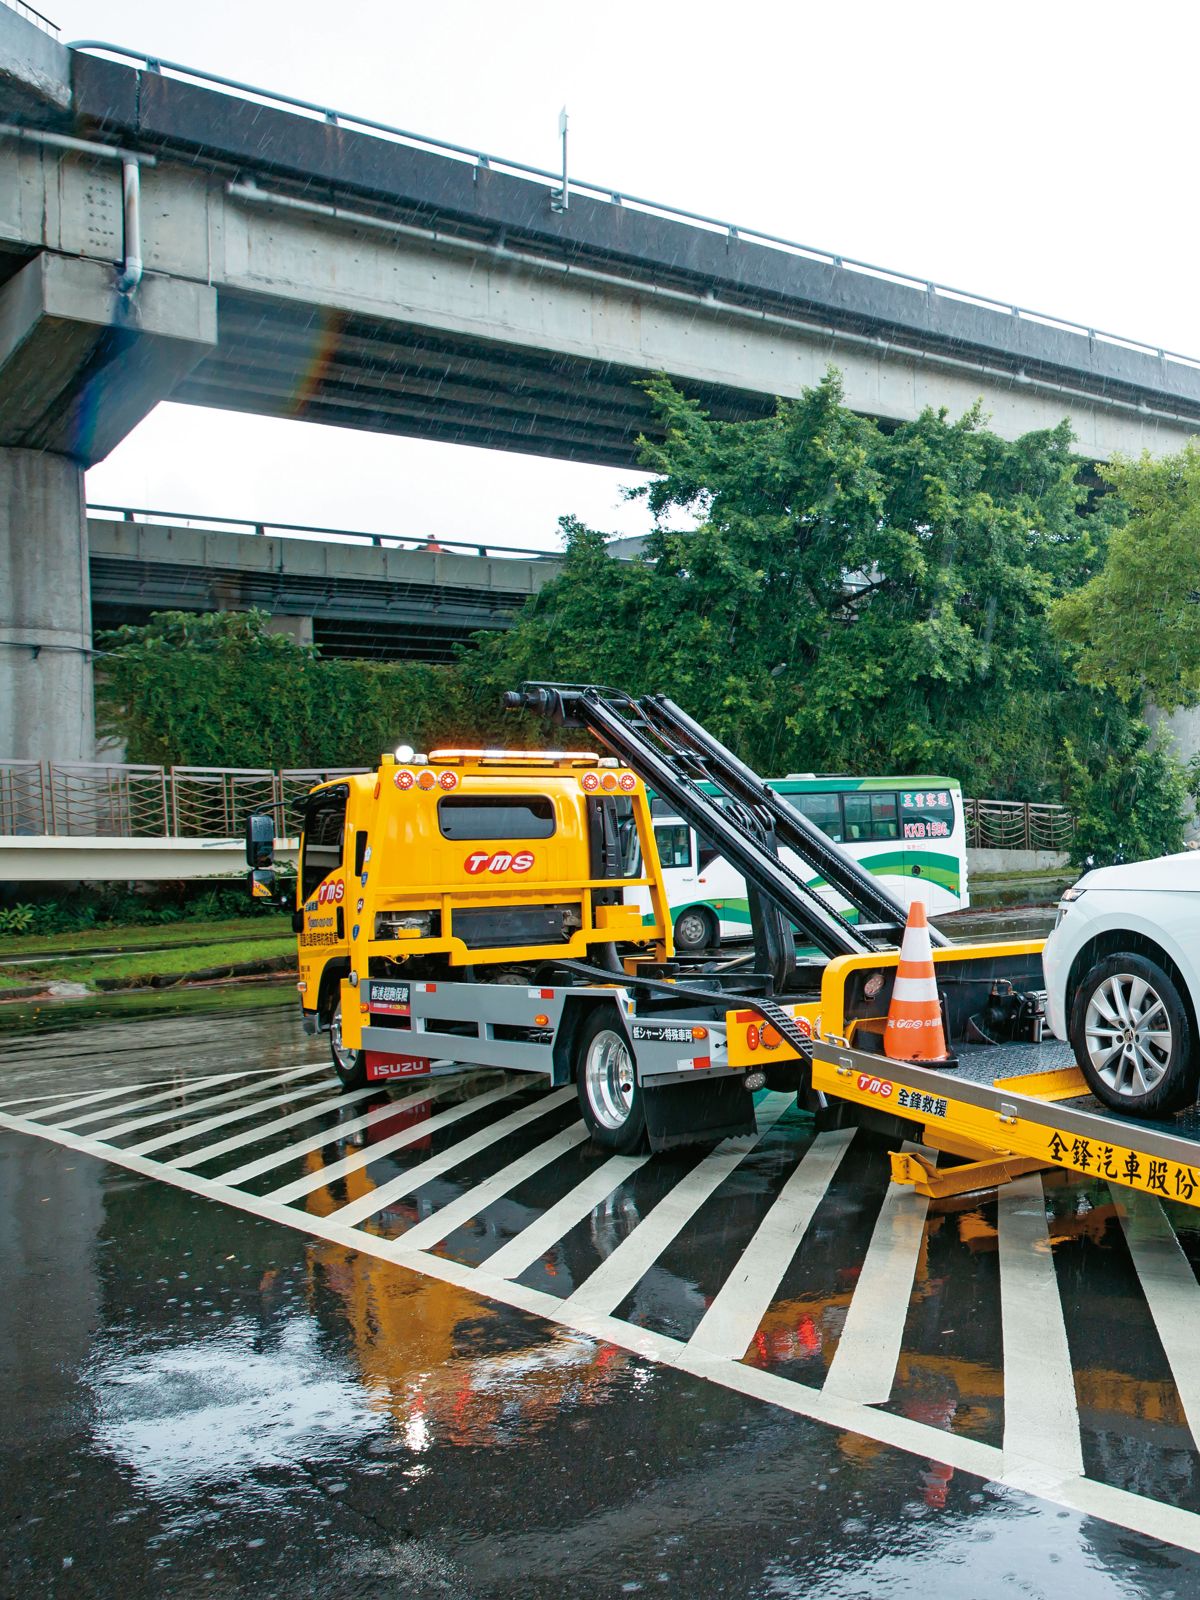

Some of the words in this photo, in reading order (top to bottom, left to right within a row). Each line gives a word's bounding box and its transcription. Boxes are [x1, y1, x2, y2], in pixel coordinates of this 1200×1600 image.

[904, 822, 925, 838] KKB
[470, 855, 534, 871] TMS
[319, 883, 344, 901] TMS
[373, 1060, 424, 1076] ISUZU
[858, 1076, 893, 1096] TMS
[898, 1088, 948, 1118] 全鋒救援
[1047, 1131, 1199, 1201] 全鋒汽車股份
